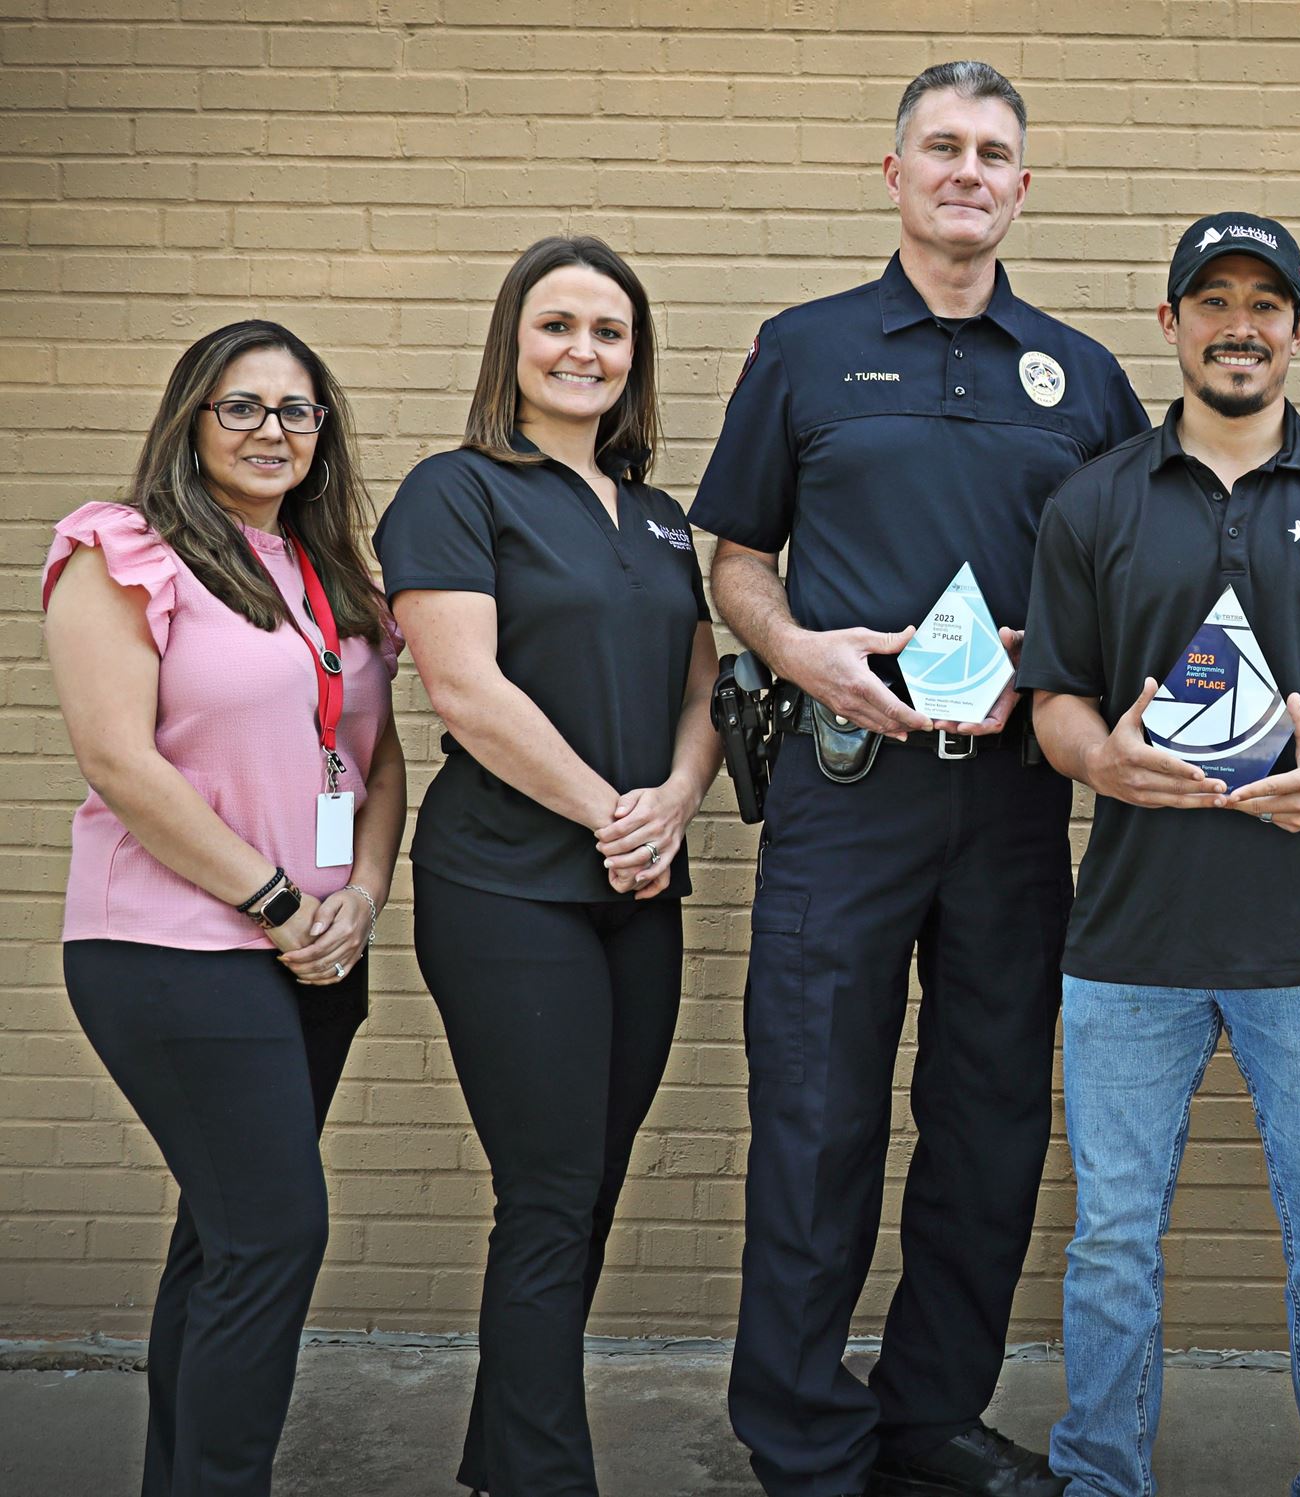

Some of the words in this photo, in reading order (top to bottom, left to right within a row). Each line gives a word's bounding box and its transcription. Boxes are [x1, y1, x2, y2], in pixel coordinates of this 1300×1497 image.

[844, 373, 852, 381] J.
[855, 372, 900, 381] TURNER
[934, 613, 955, 623] 2023
[942, 633, 962, 641] PLACE
[1187, 653, 1215, 664] 2023
[1187, 665, 1225, 674] Programming
[1198, 680, 1226, 690] PLACE
